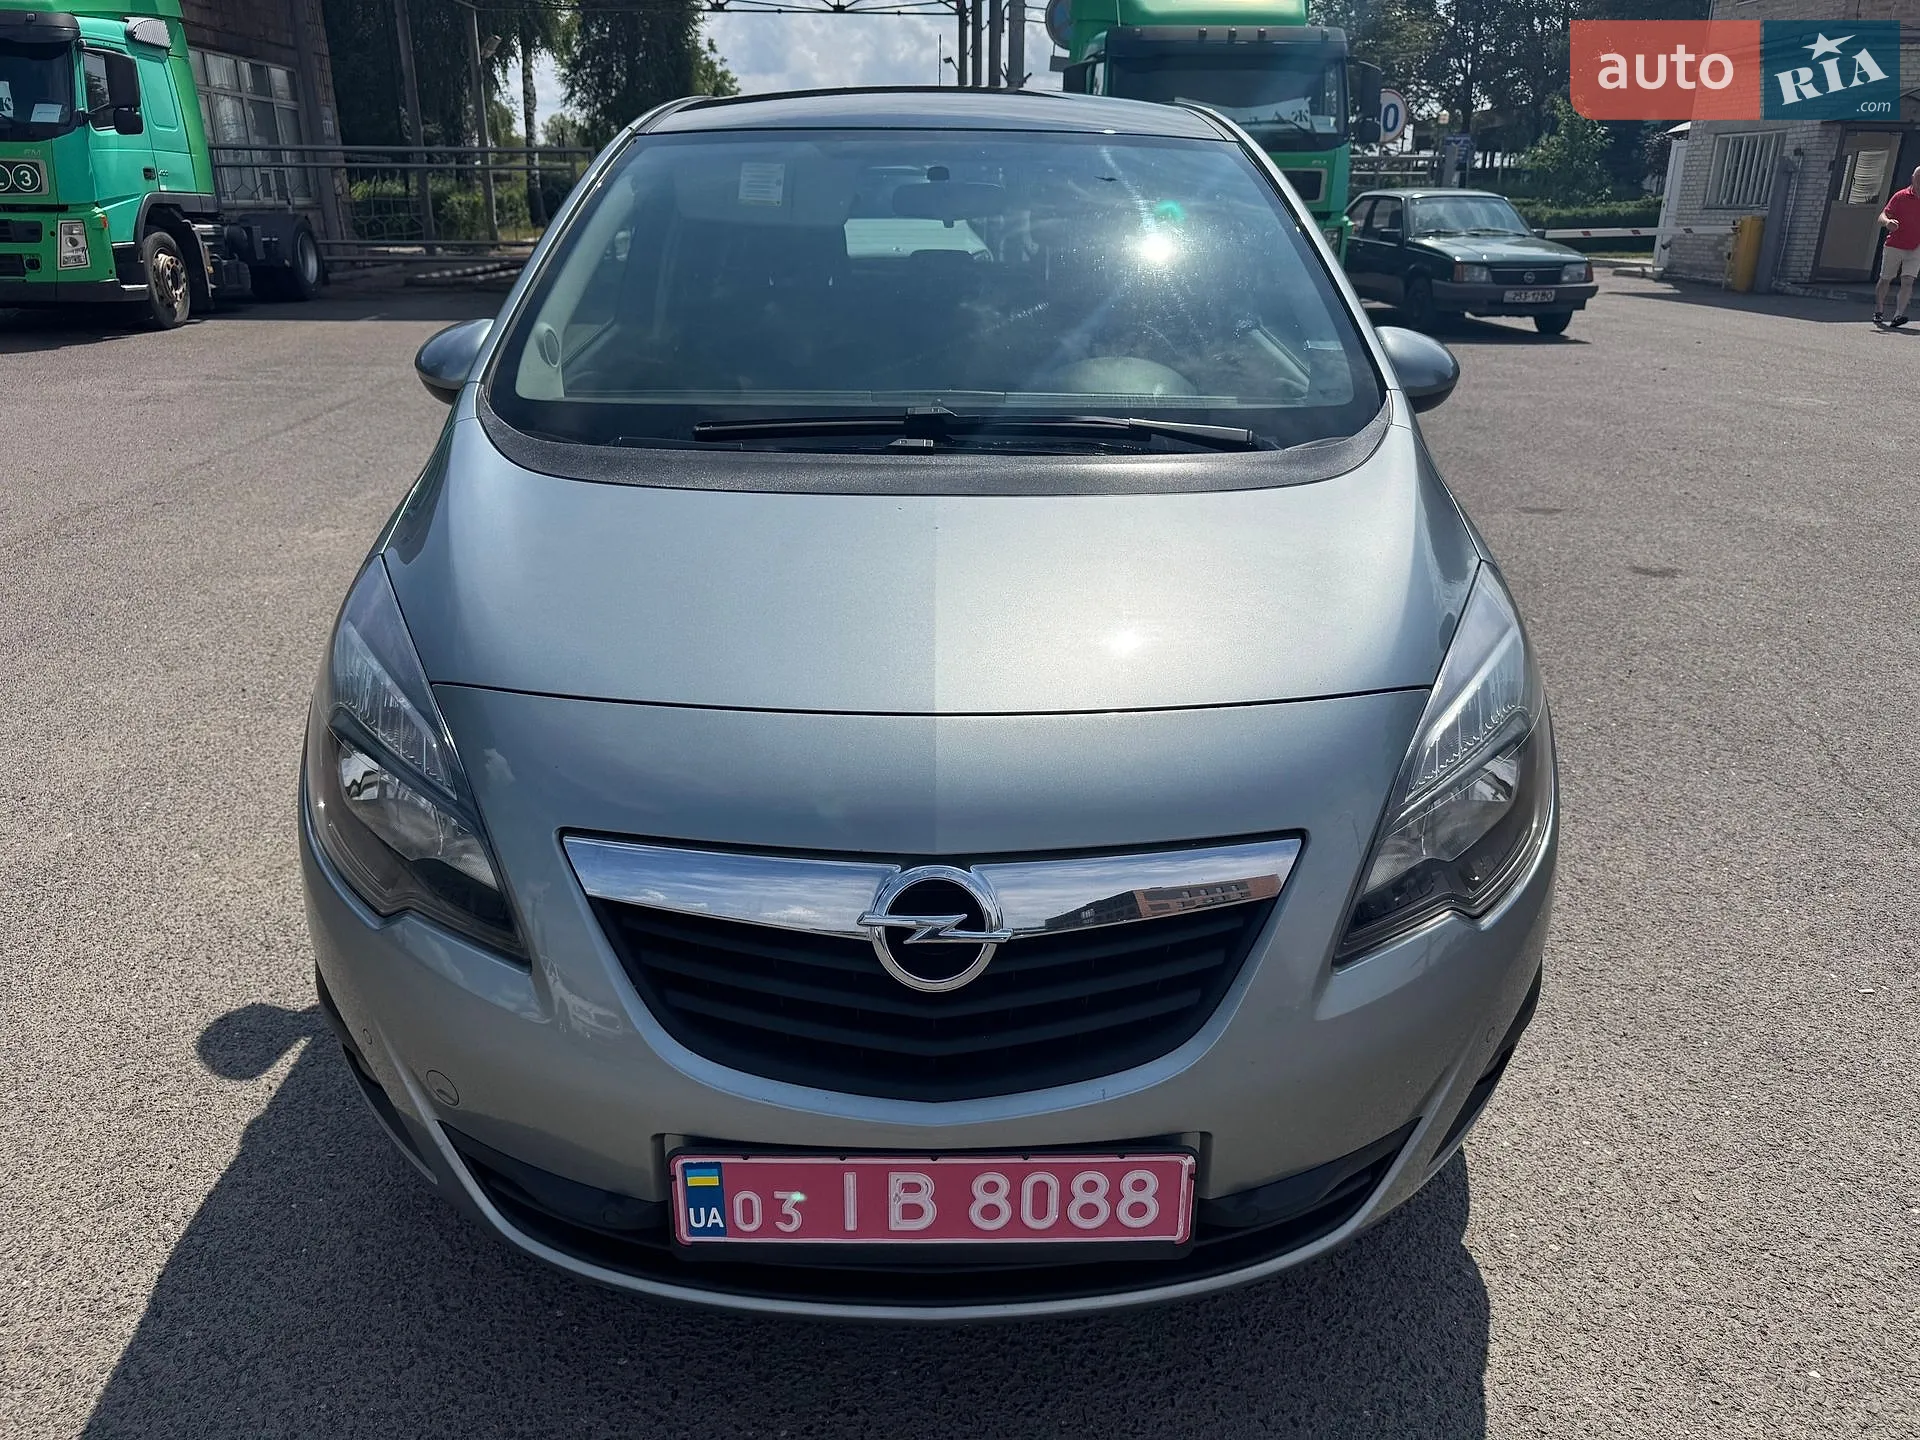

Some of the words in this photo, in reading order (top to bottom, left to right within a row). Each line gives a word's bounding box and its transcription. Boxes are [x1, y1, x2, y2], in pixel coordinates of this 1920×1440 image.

[1382, 103, 1399, 132] 0
[19, 169, 32, 187] 3
[688, 1207, 724, 1228] UA
[732, 1190, 803, 1233] 03
[969, 1169, 1160, 1231] 8088
